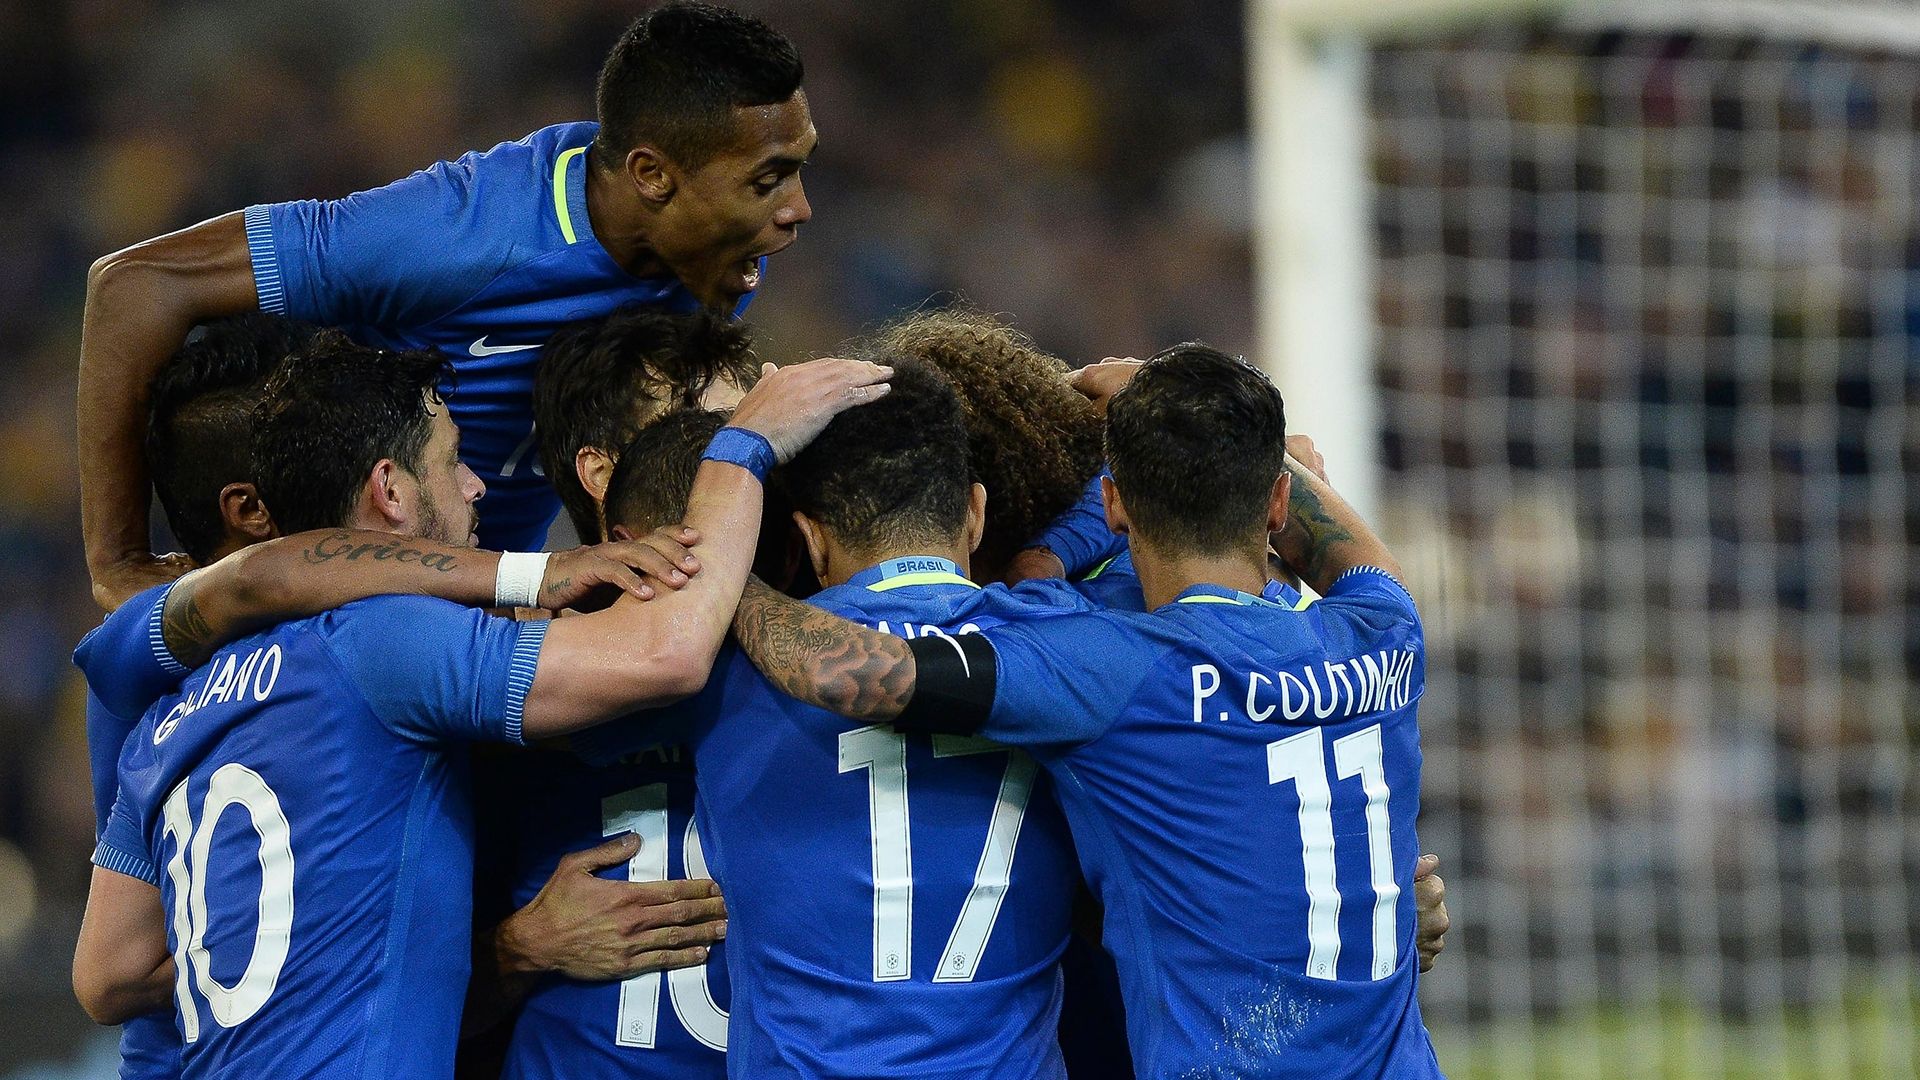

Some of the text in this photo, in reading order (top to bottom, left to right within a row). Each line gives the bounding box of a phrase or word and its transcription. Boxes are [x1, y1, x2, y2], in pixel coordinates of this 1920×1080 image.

[896, 560, 948, 574] BRASIL
[1191, 649, 1415, 723] P. COUTINHO
[162, 762, 295, 1044] 10
[838, 723, 1040, 984] 17
[1266, 723, 1401, 982] 11
